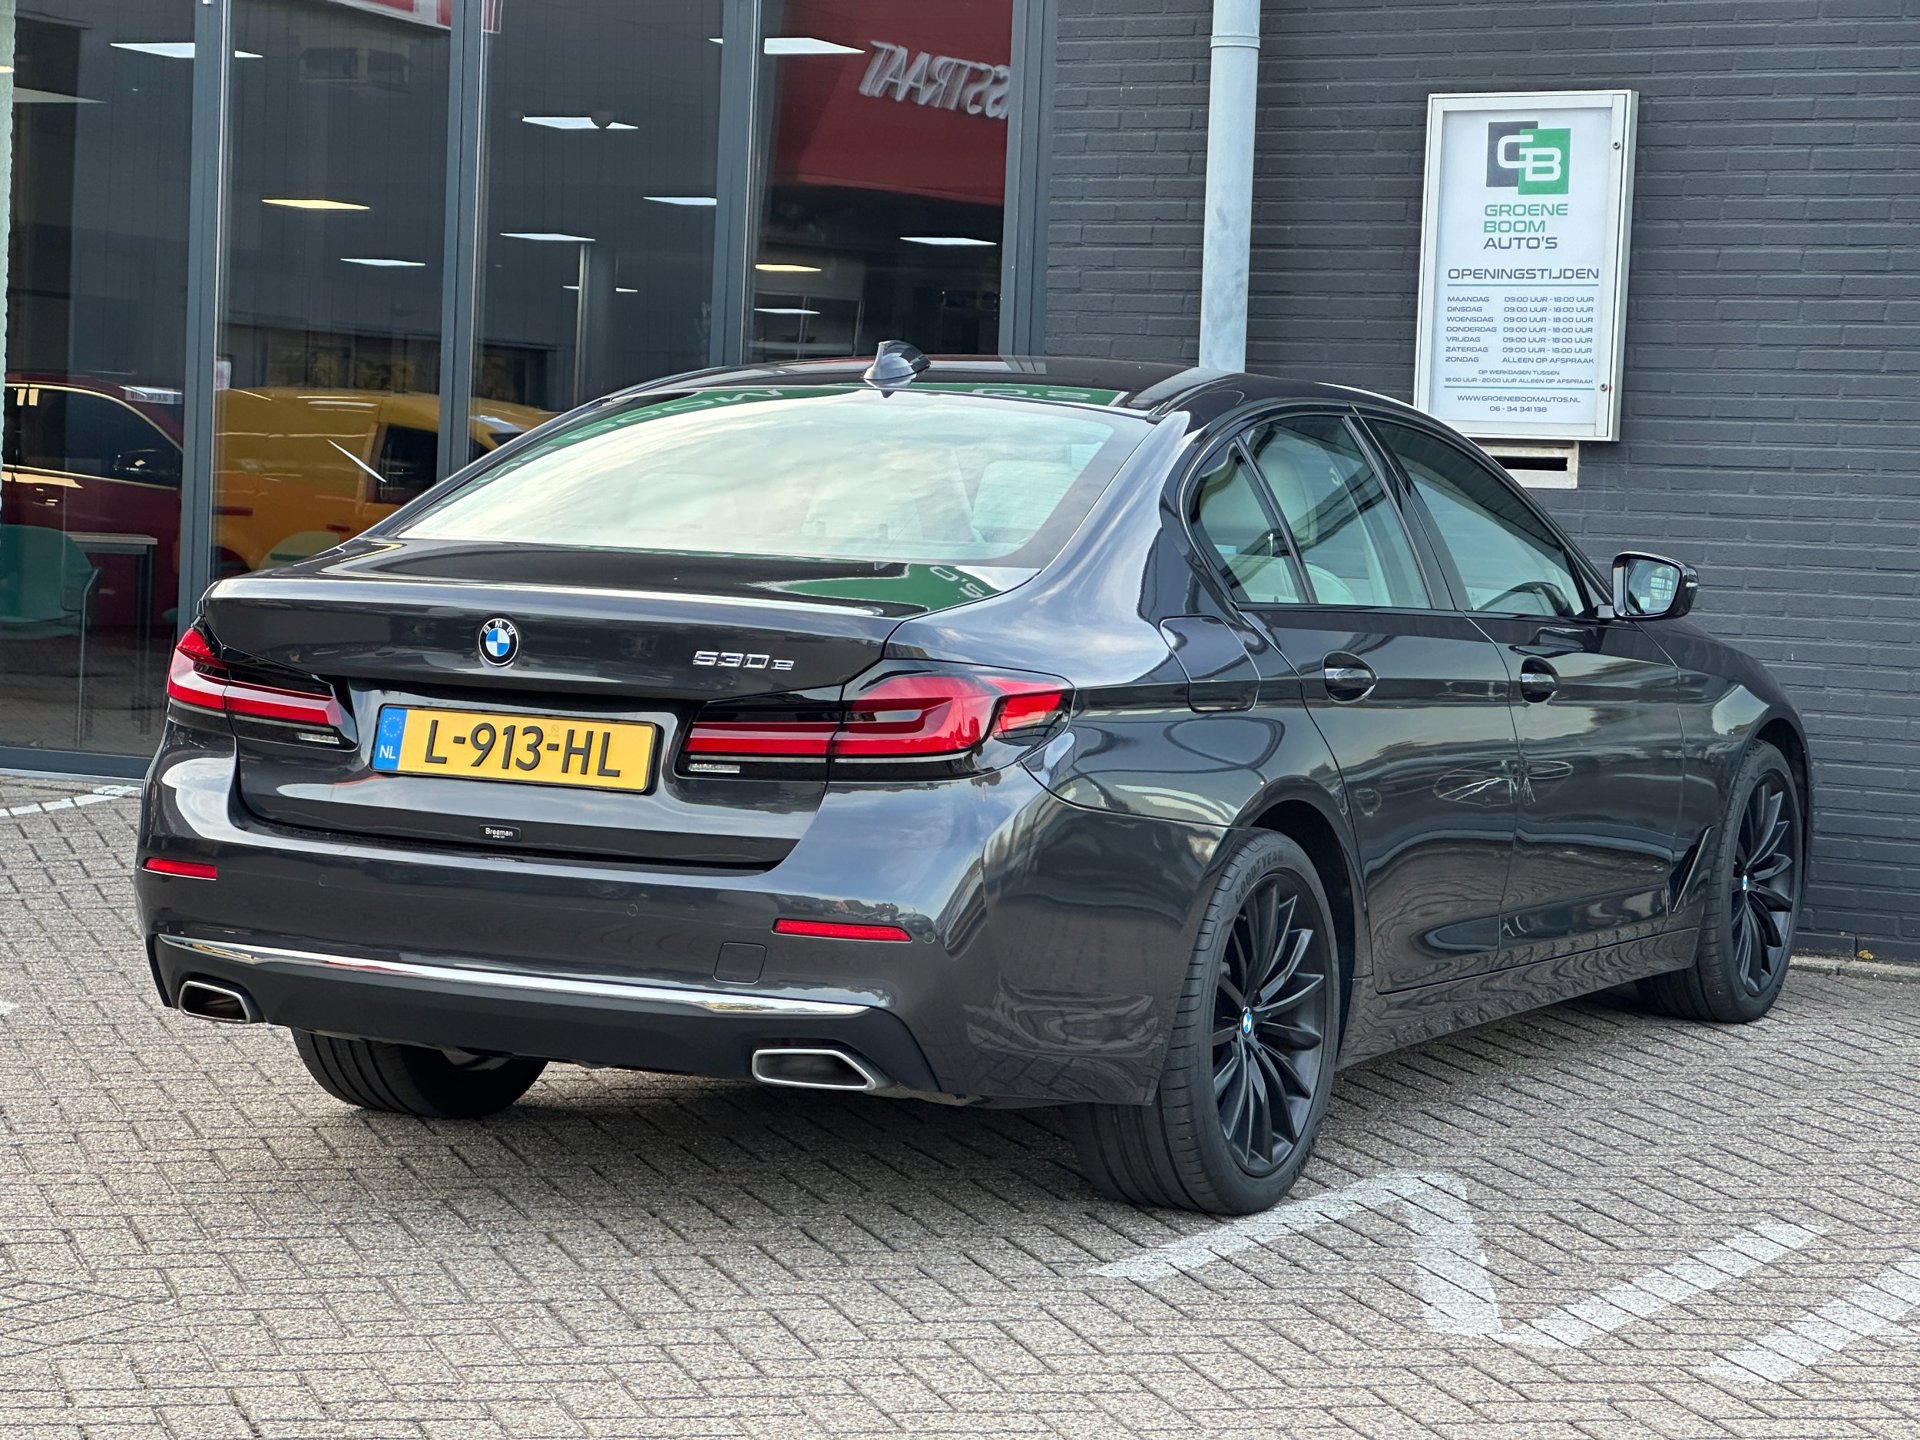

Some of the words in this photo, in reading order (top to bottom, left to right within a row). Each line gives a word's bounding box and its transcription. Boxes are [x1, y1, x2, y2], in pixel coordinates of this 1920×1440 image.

[1484, 203, 1569, 217] GROENE
[1483, 220, 1546, 233] BOOM
[1483, 236, 1558, 250] AUTO'S
[1447, 268, 1599, 280] OPENINGSTIJDEN
[1549, 357, 1595, 365] AFSPRAAK
[1457, 395, 1581, 403] WWW.GROENEBOOMAUTOS.NL
[483, 620, 515, 636] BMW
[379, 745, 396, 760] NL
[424, 719, 621, 778] L-913-HL
